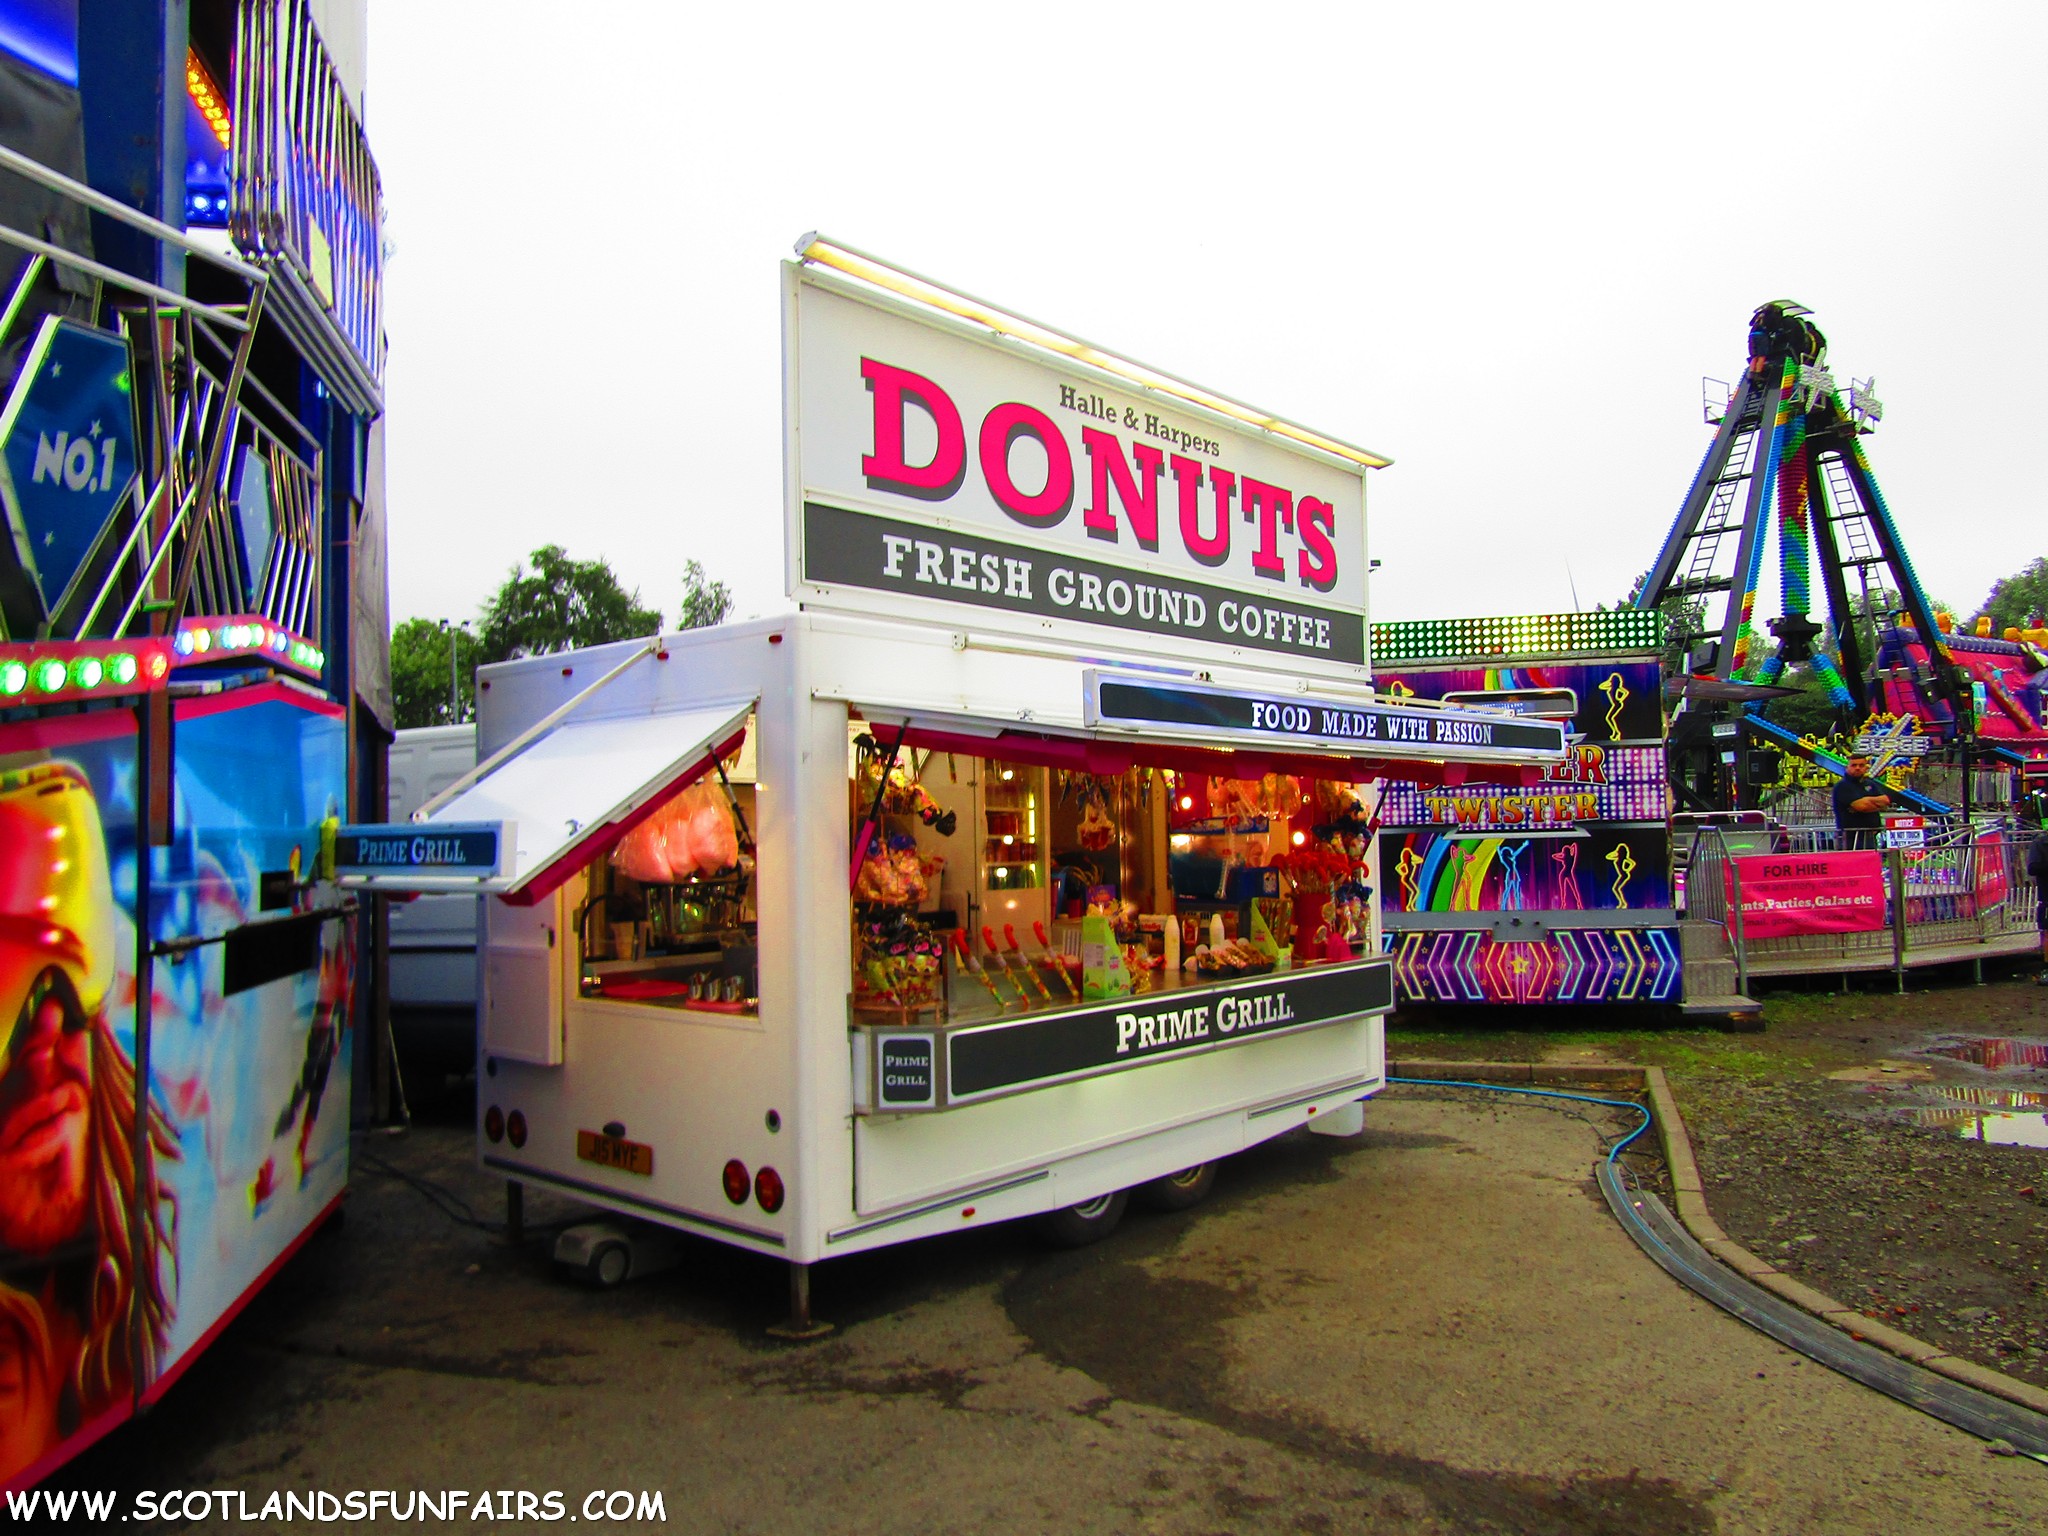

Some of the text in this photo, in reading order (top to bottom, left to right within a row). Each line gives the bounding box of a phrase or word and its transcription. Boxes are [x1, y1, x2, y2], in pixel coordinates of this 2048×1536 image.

[1059, 384, 1220, 457] Halle & Harpers
[32, 430, 117, 495] NO.1
[860, 354, 1337, 594] DONUTS
[882, 533, 1332, 650] FRESH GROUND COFFEE
[1251, 702, 1492, 744] FOOD MADE WITH PASSION
[1425, 792, 1600, 825] TWISTER
[357, 838, 408, 864] PRIME
[1763, 863, 1828, 878] FOR HIRE
[1854, 895, 1873, 905] etc
[1116, 1005, 1209, 1054] PRIME
[885, 1055, 929, 1067] PRIME
